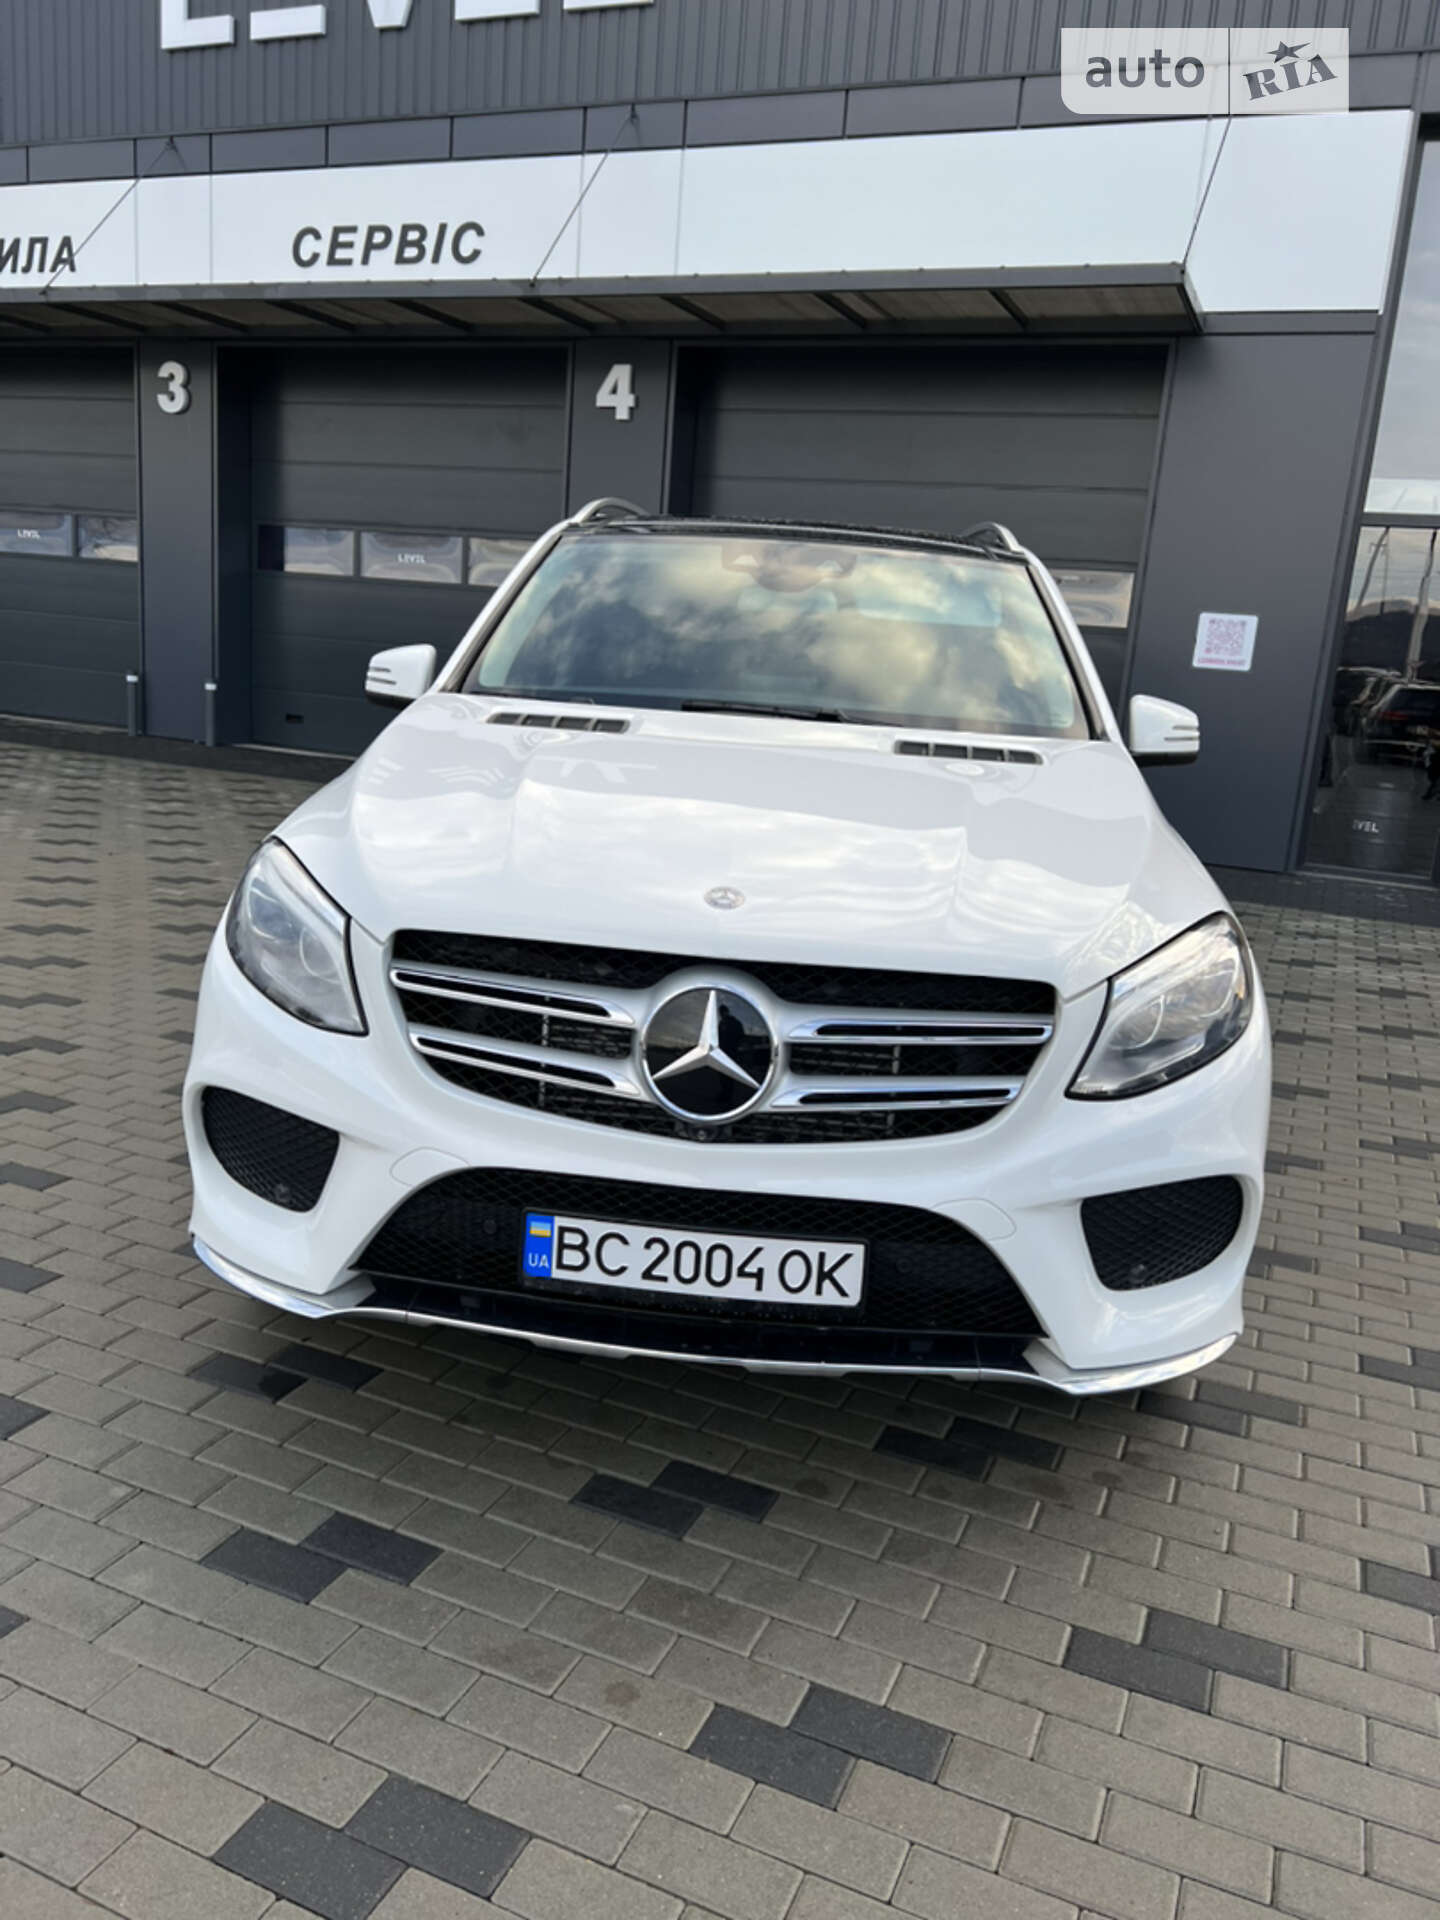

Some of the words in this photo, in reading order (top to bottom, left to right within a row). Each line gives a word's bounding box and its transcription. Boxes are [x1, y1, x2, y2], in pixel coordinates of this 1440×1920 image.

[292, 221, 485, 268] СЕРВІС
[156, 360, 188, 414] 3
[595, 363, 636, 420] 4
[528, 1253, 550, 1269] UA
[555, 1225, 630, 1277] BC
[640, 1237, 765, 1292] 2004
[777, 1249, 855, 1298] OK
